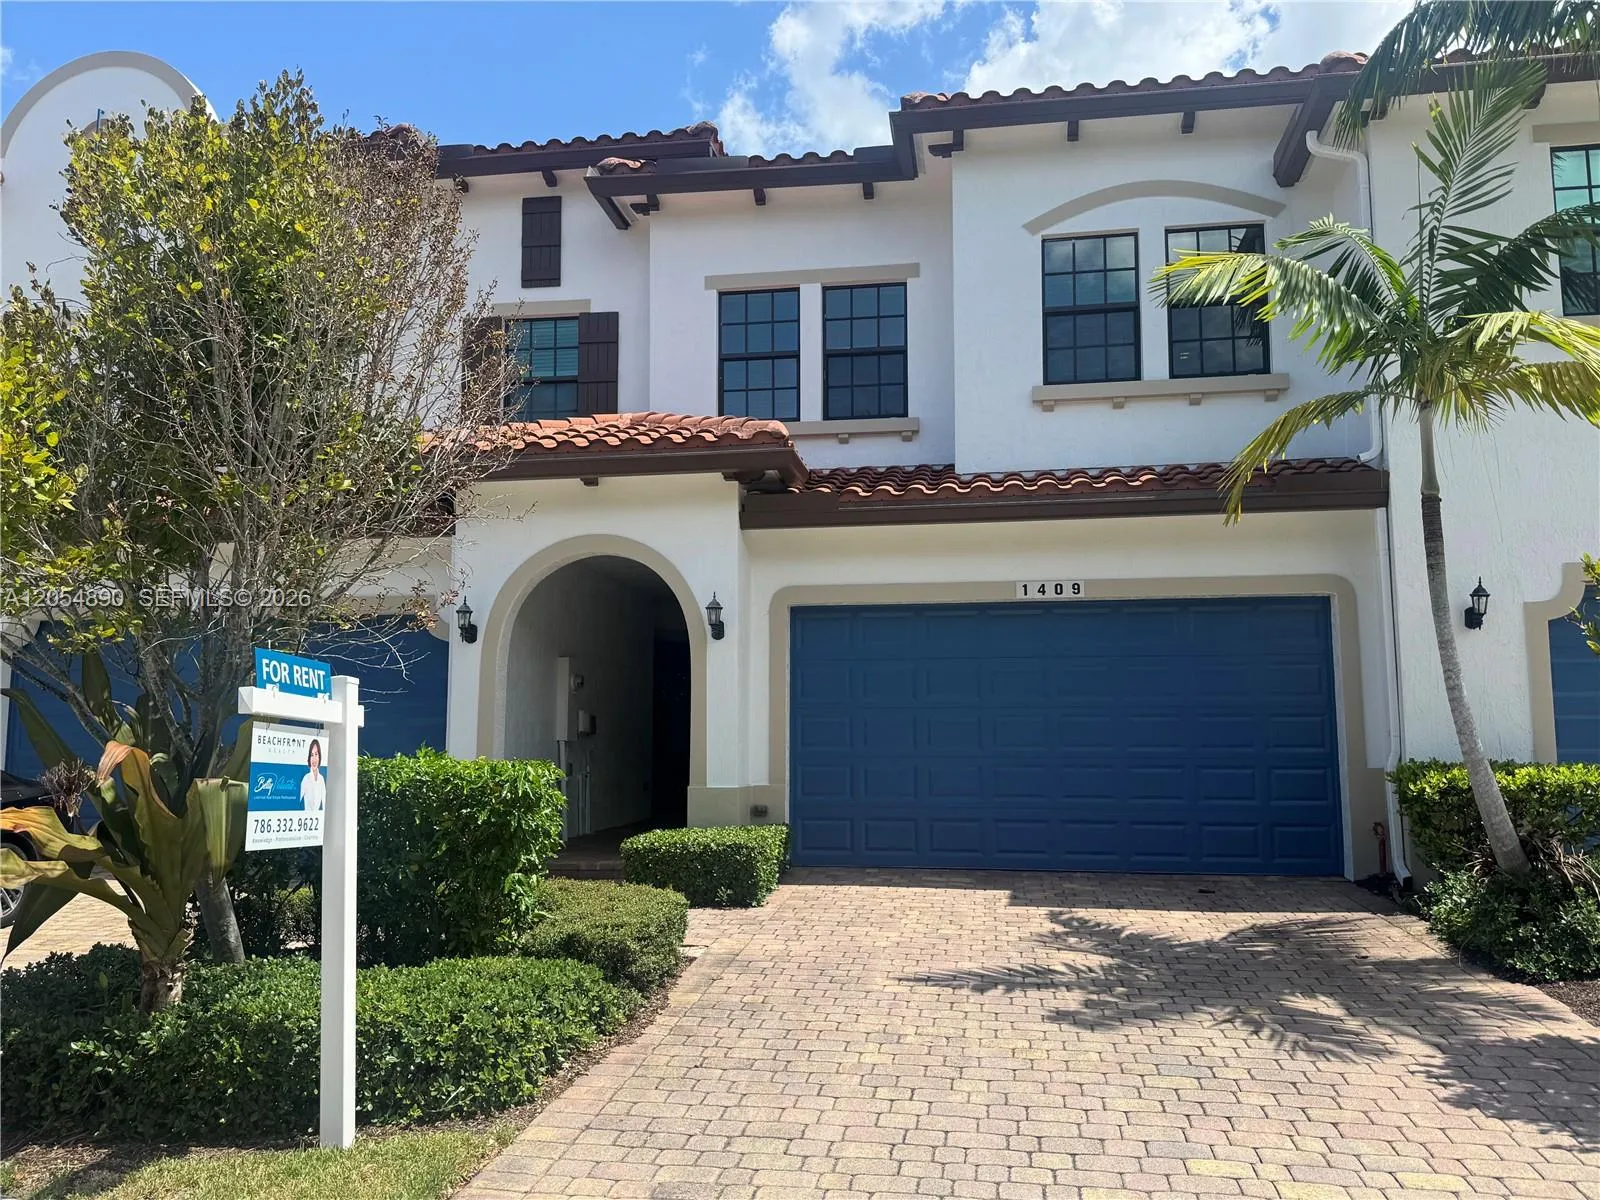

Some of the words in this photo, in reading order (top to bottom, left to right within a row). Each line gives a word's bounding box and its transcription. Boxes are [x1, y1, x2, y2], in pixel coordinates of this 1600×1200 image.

[1022, 583, 1081, 596] 1409
[262, 658, 290, 684] FOR
[292, 664, 326, 690] RENT
[257, 735, 306, 748] BEACHFRONT
[254, 817, 319, 834] 786.332.9622
